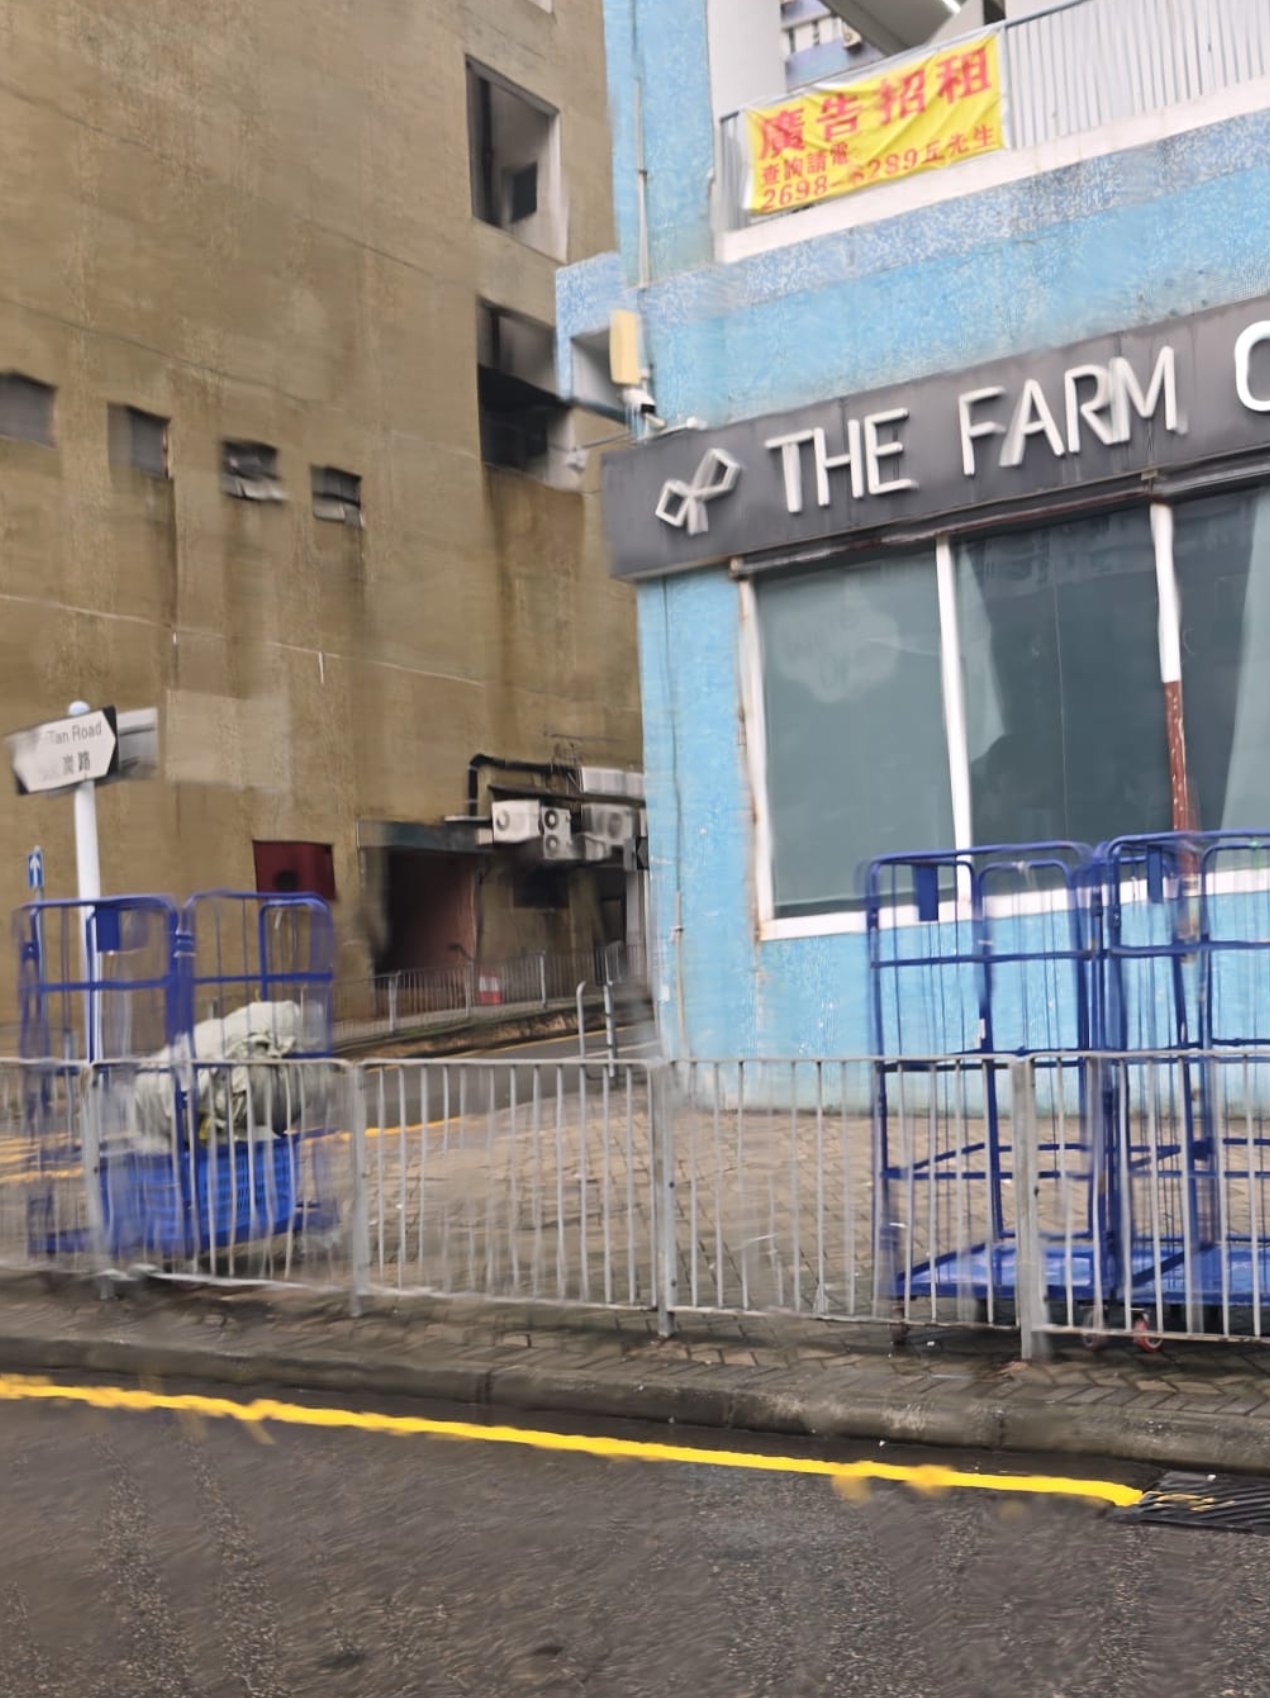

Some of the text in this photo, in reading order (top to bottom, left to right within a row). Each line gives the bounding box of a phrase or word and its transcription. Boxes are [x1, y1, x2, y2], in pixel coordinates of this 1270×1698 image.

[759, 46, 992, 160] 廣告招租
[764, 407, 917, 513] THE
[958, 345, 1186, 476] FARM
[72, 722, 102, 742] Road
